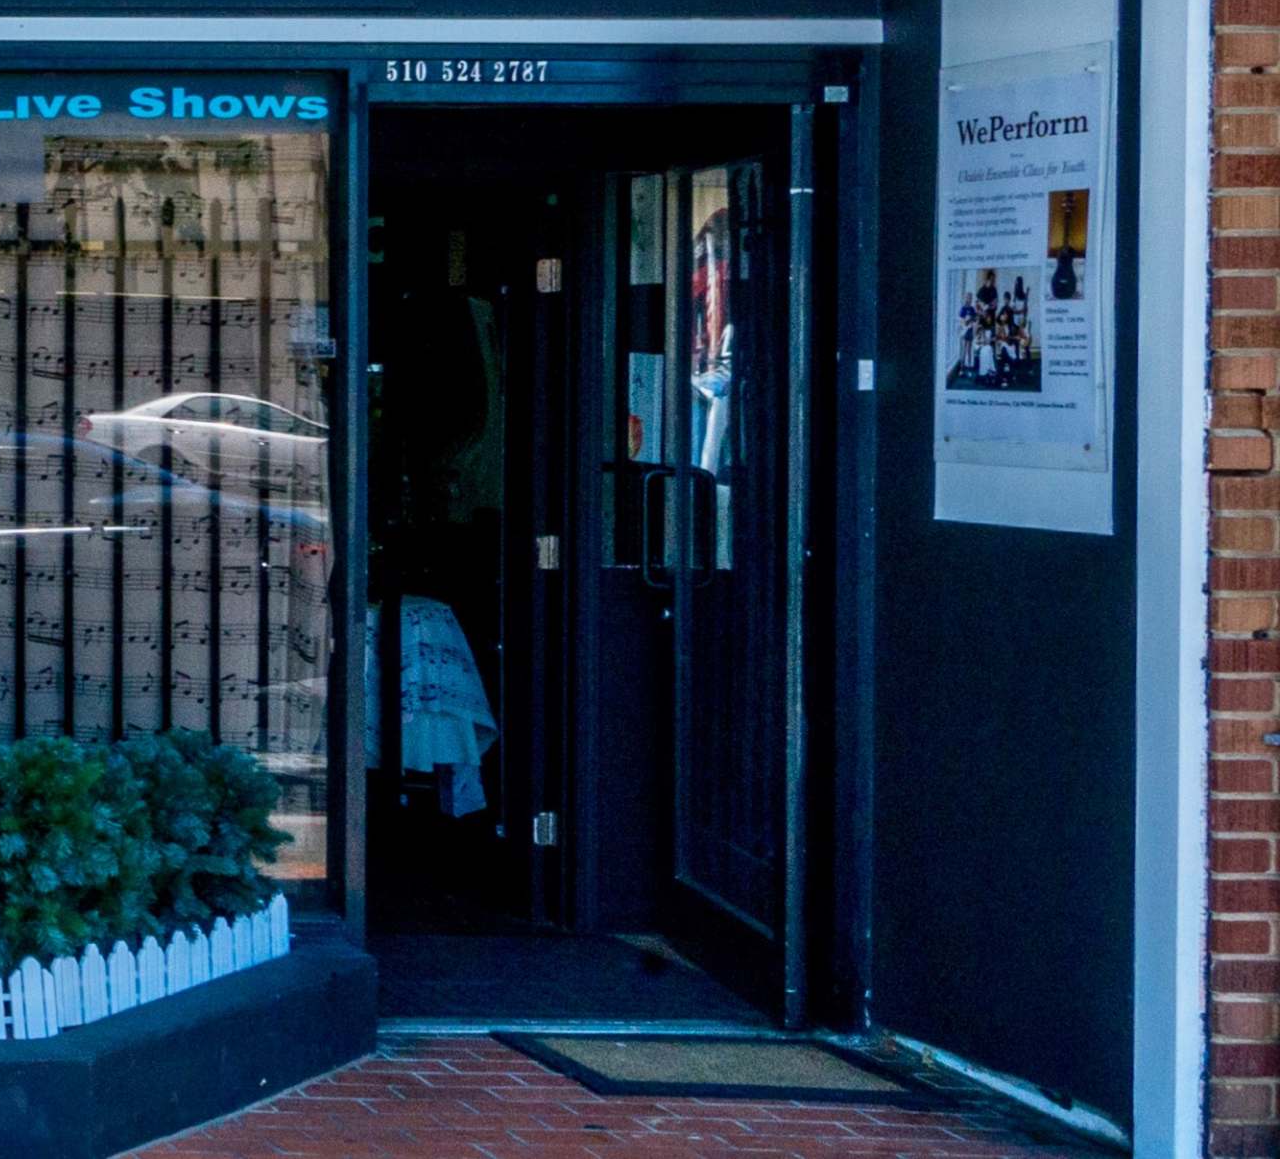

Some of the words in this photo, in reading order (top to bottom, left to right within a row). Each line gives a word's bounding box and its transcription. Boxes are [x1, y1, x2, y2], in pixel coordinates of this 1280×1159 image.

[386, 60, 427, 82] 510
[441, 60, 481, 82] 524
[494, 61, 548, 82] 2787
[128, 87, 329, 120] Shows
[957, 111, 1089, 147] WePerform
